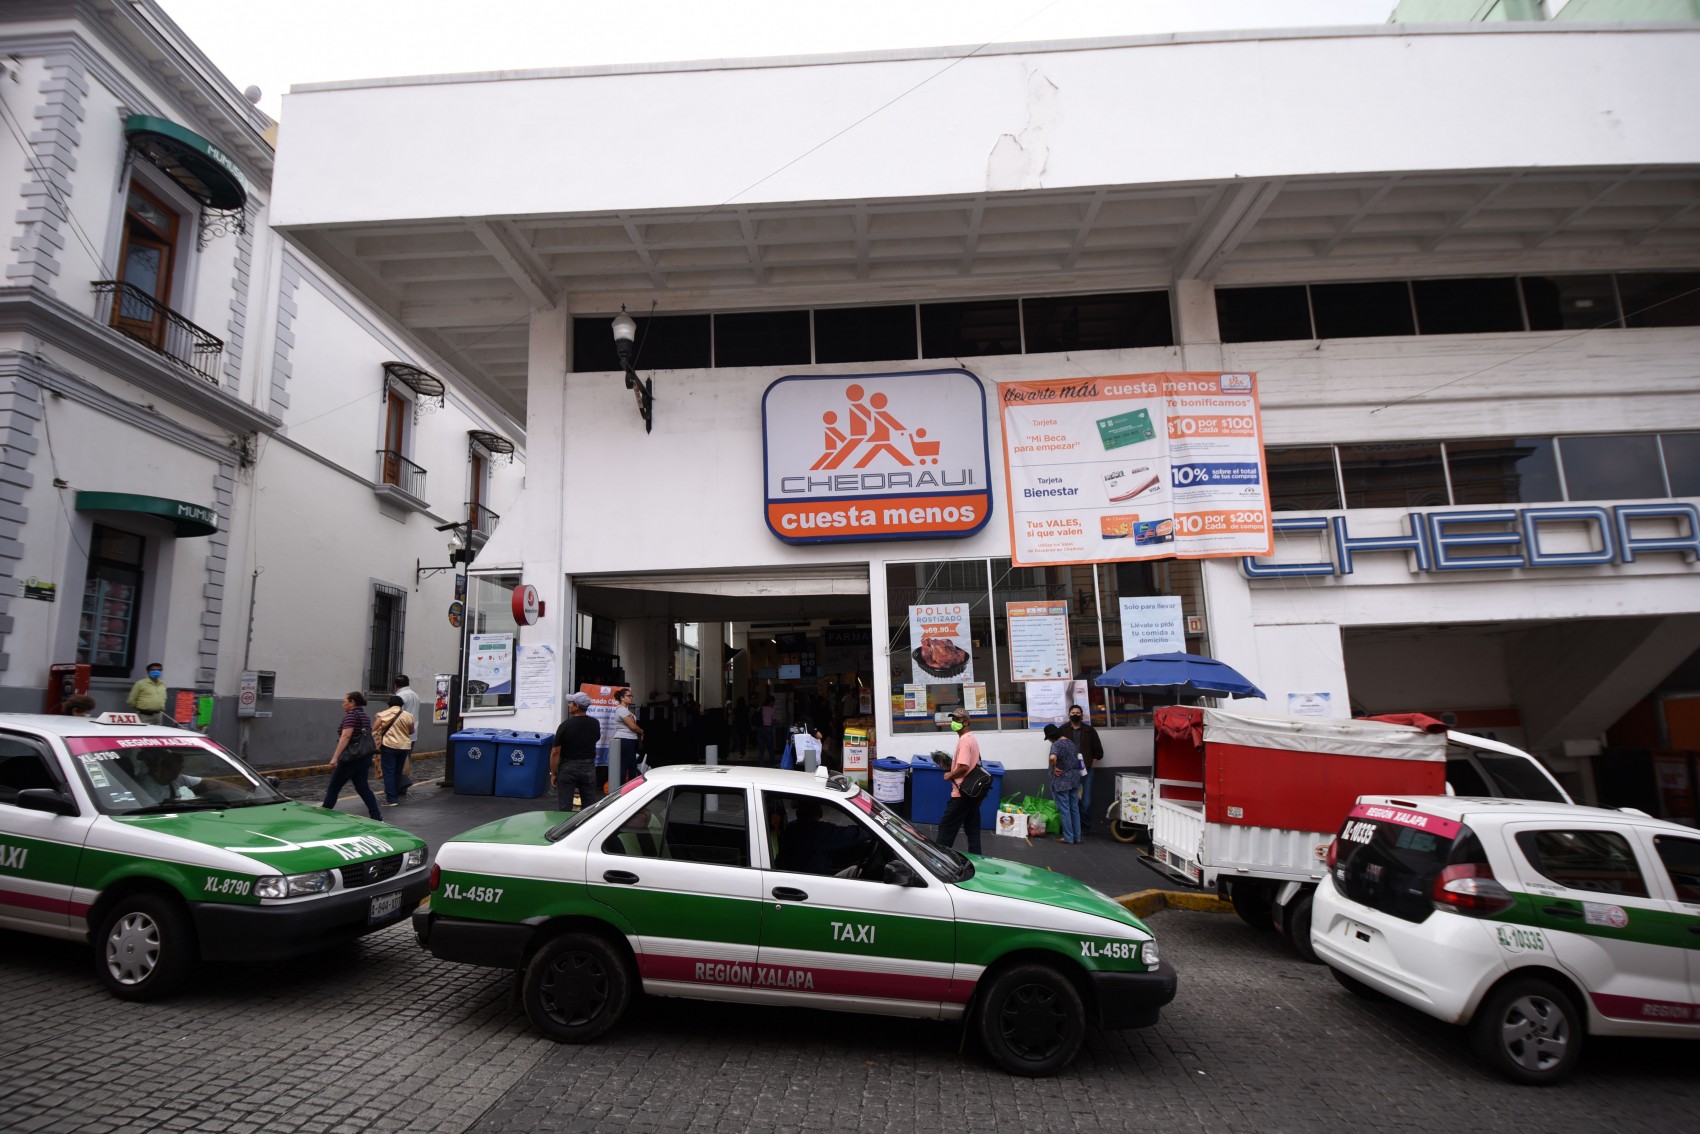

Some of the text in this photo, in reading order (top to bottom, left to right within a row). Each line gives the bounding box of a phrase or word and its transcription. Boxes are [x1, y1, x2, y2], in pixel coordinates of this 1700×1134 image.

[1004, 387, 1057, 401] llevarte
[1060, 382, 1099, 398] más
[1104, 381, 1157, 396] cuesta
[1162, 380, 1217, 392] menos
[1167, 399, 1178, 407] Te
[1032, 419, 1057, 427] Tarjeta
[1168, 417, 1253, 435] $10 por $100
[1198, 425, 1219, 433] cada
[1044, 434, 1067, 442] Beca
[1014, 445, 1034, 453] para
[781, 468, 973, 493] CHEDRAUI
[1037, 477, 1063, 485] Tarjeta
[1172, 467, 1209, 485] 10%
[1024, 487, 1079, 498] Bienestar
[781, 505, 976, 529] cuesta menos
[1174, 512, 1263, 532] $10 por $200
[1026, 518, 1082, 528] Tus VALES,
[1205, 521, 1227, 529] cada
[1037, 530, 1055, 538] que
[1057, 527, 1083, 536] valen
[916, 605, 962, 616] POLLO
[916, 614, 962, 623] ROSTIZADO
[109, 714, 137, 723] TAXI
[116, 738, 161, 748] REGIÓN
[77, 751, 121, 764] XL-8790
[1366, 807, 1428, 828] REGIÓN XALAPA
[204, 876, 251, 896] XL-8790
[443, 883, 504, 904] XL-4587
[830, 921, 876, 944] TAXI
[1080, 941, 1138, 959] XL-4587
[695, 961, 815, 989] REGIÓN XALAPA
